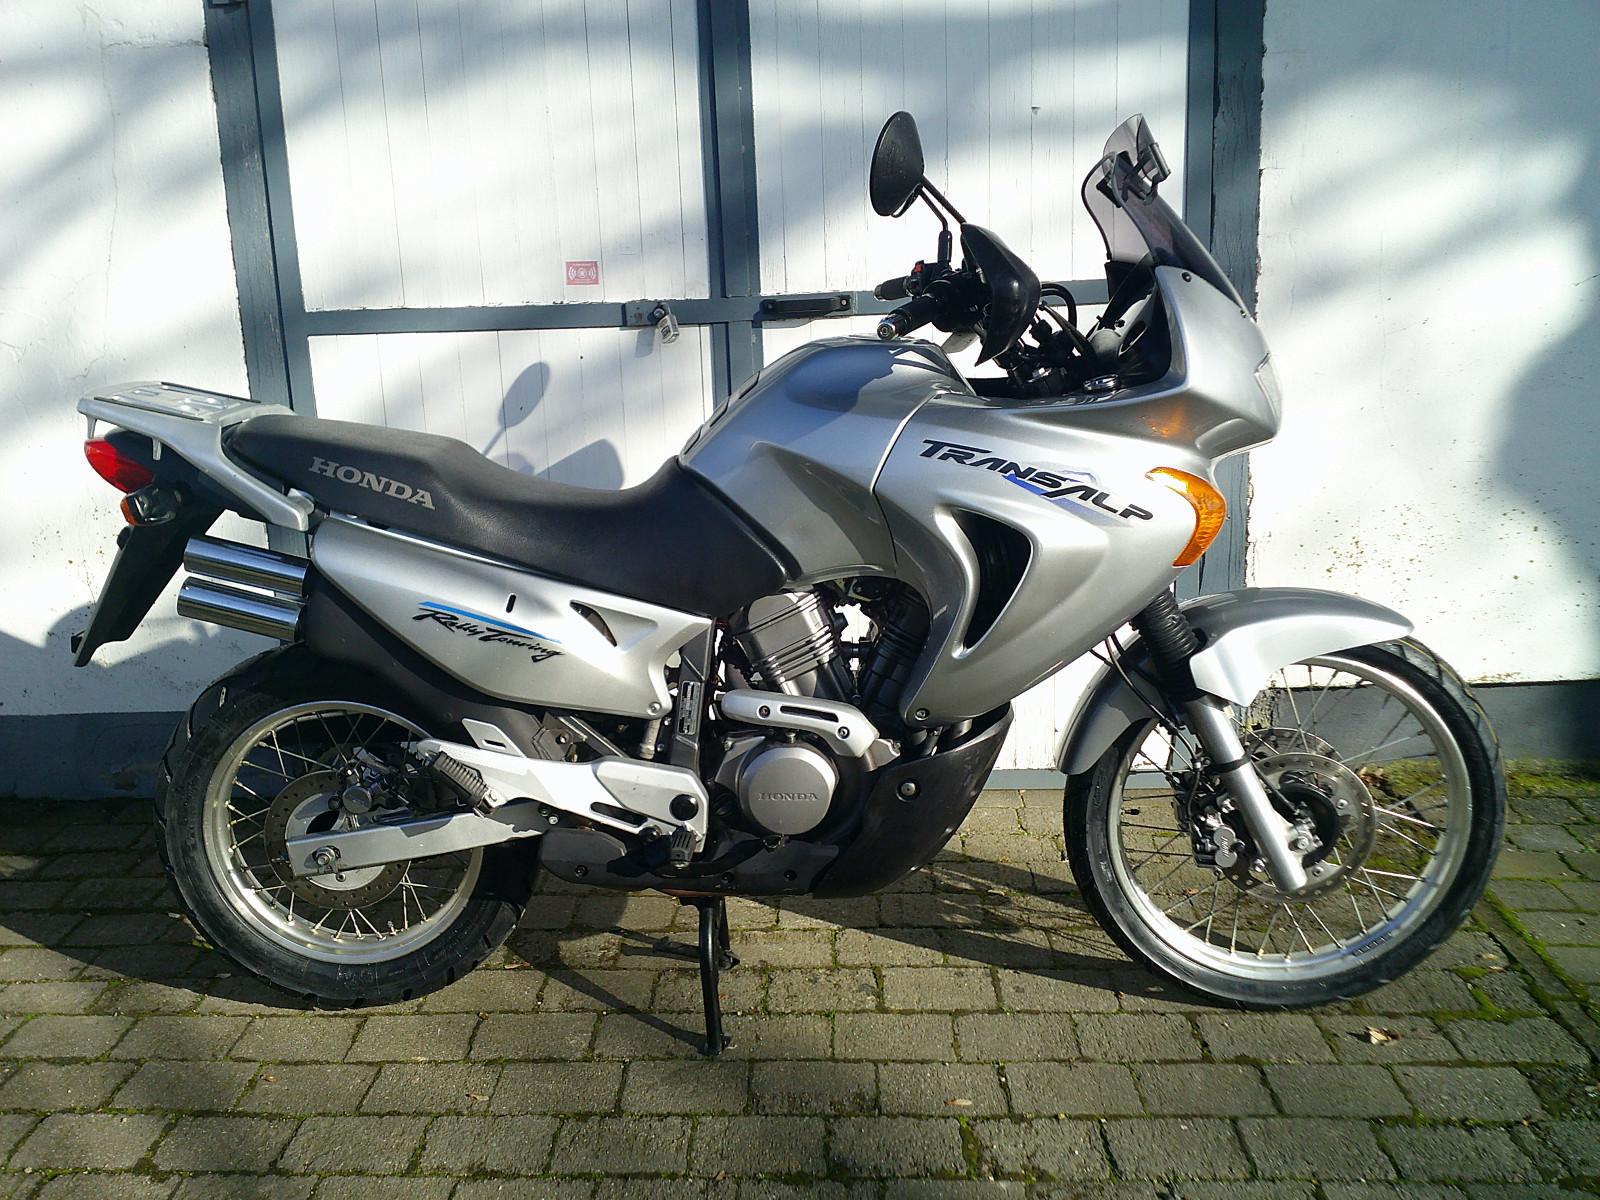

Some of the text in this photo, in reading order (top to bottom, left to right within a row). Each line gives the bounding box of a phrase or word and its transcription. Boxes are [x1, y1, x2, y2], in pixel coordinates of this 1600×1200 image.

[308, 456, 436, 511] HONDA
[919, 439, 1154, 521] TRANSALP
[412, 607, 565, 663] Rally Touring
[758, 792, 818, 801] HONDA
